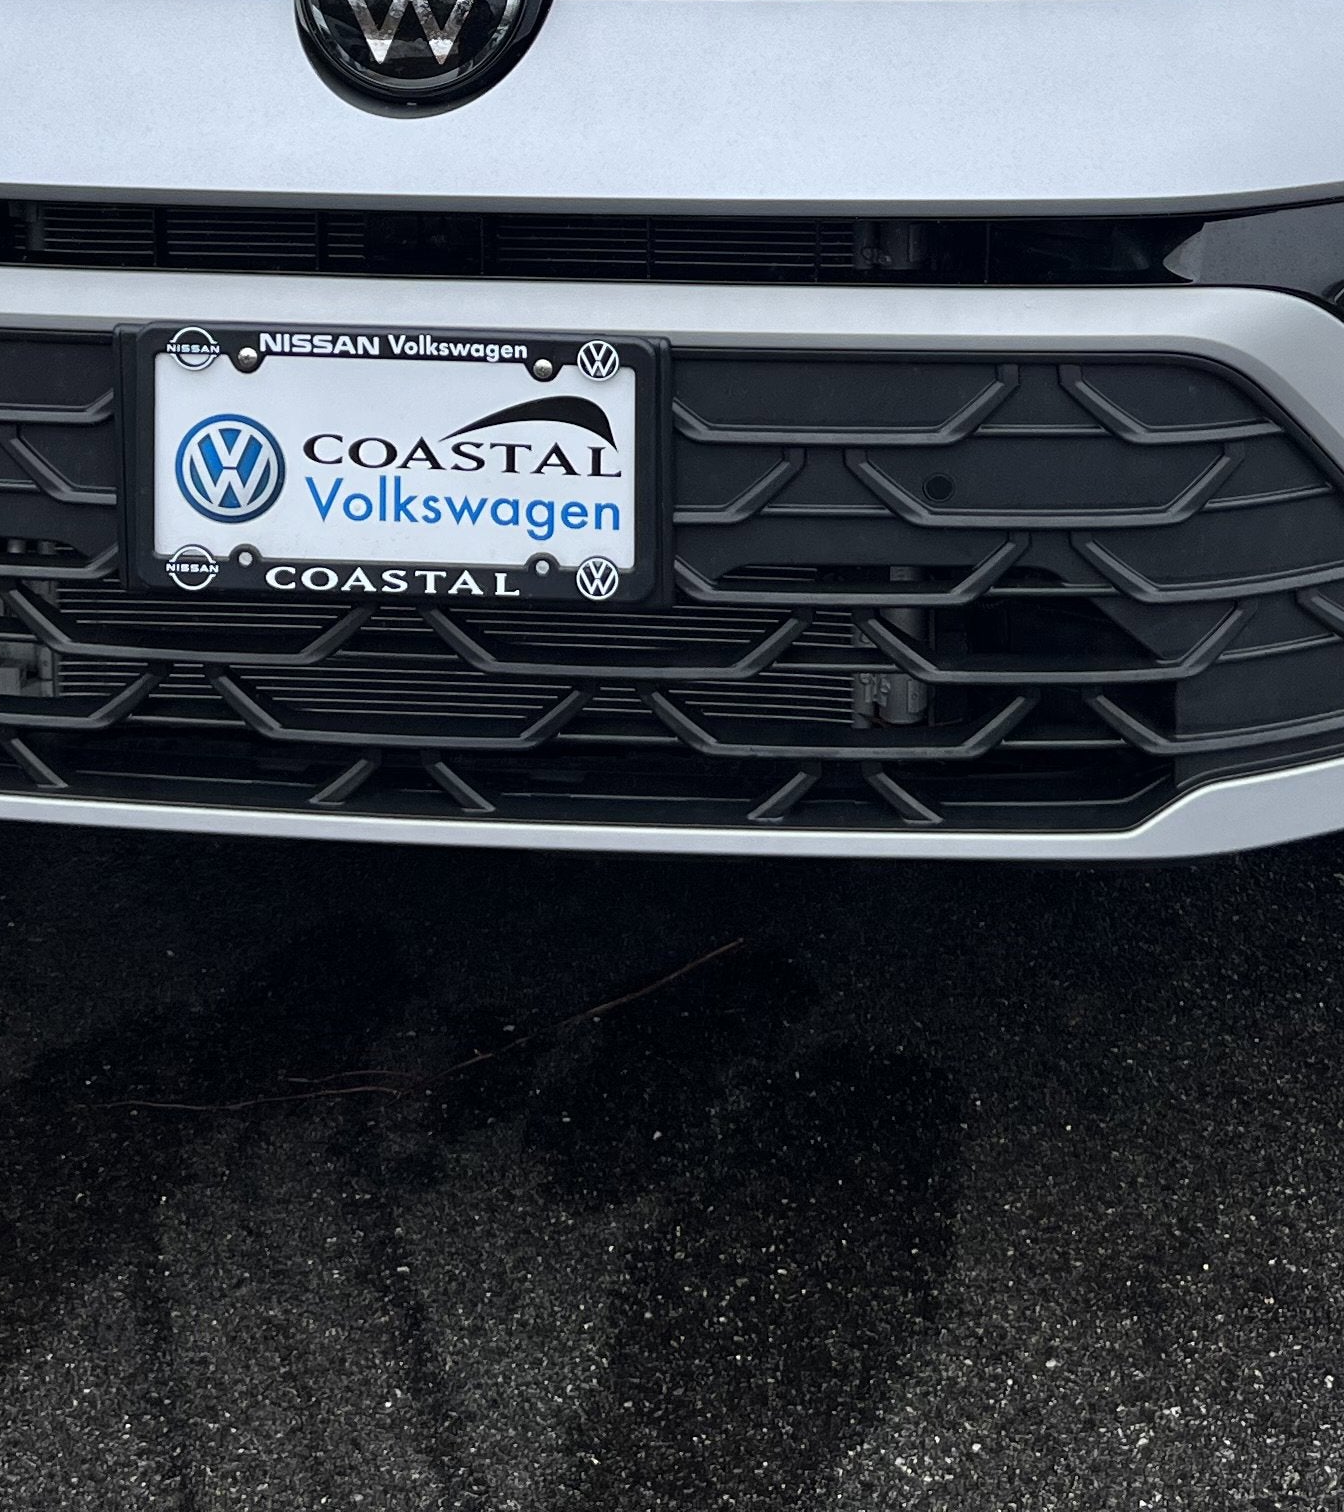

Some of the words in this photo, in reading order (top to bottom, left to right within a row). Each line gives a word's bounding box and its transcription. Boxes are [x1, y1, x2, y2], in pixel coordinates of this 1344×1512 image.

[166, 343, 220, 354] NISSAN
[259, 333, 380, 356] NISSAN
[388, 335, 529, 362] Volkswagen
[303, 434, 622, 478] COASTAL
[305, 475, 621, 541] Volkswagen
[166, 563, 219, 574] NISSAN
[265, 566, 520, 596] COASTAL
